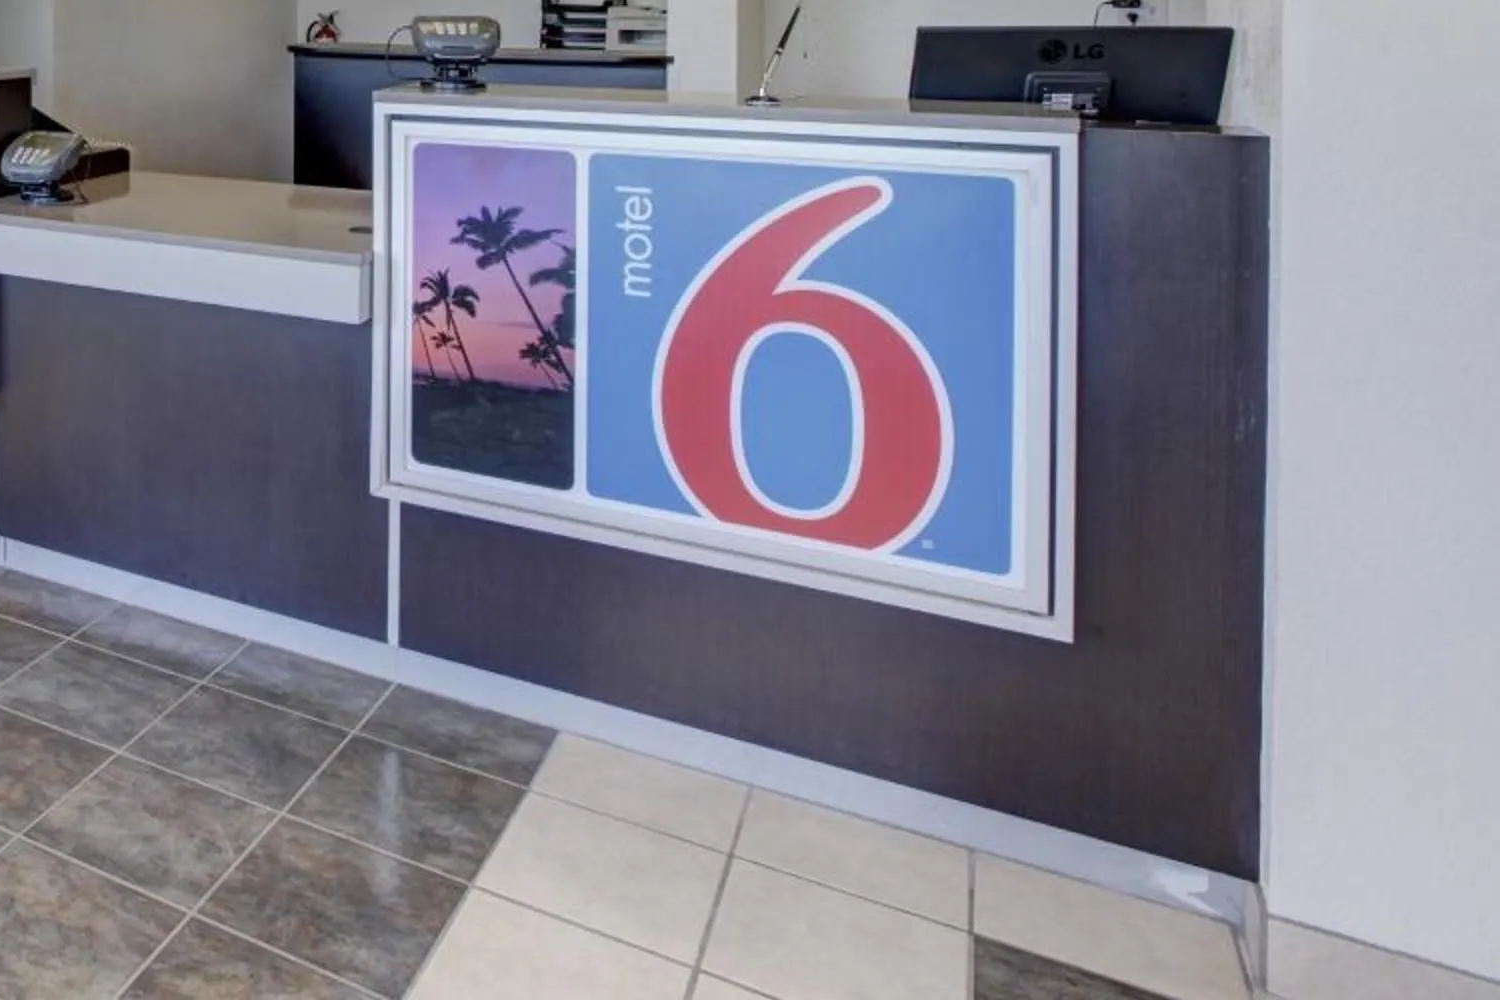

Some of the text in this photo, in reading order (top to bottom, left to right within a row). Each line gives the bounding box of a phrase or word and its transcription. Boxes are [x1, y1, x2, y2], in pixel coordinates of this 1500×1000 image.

[1073, 43, 1105, 60] LG
[615, 174, 955, 556] motel 6
